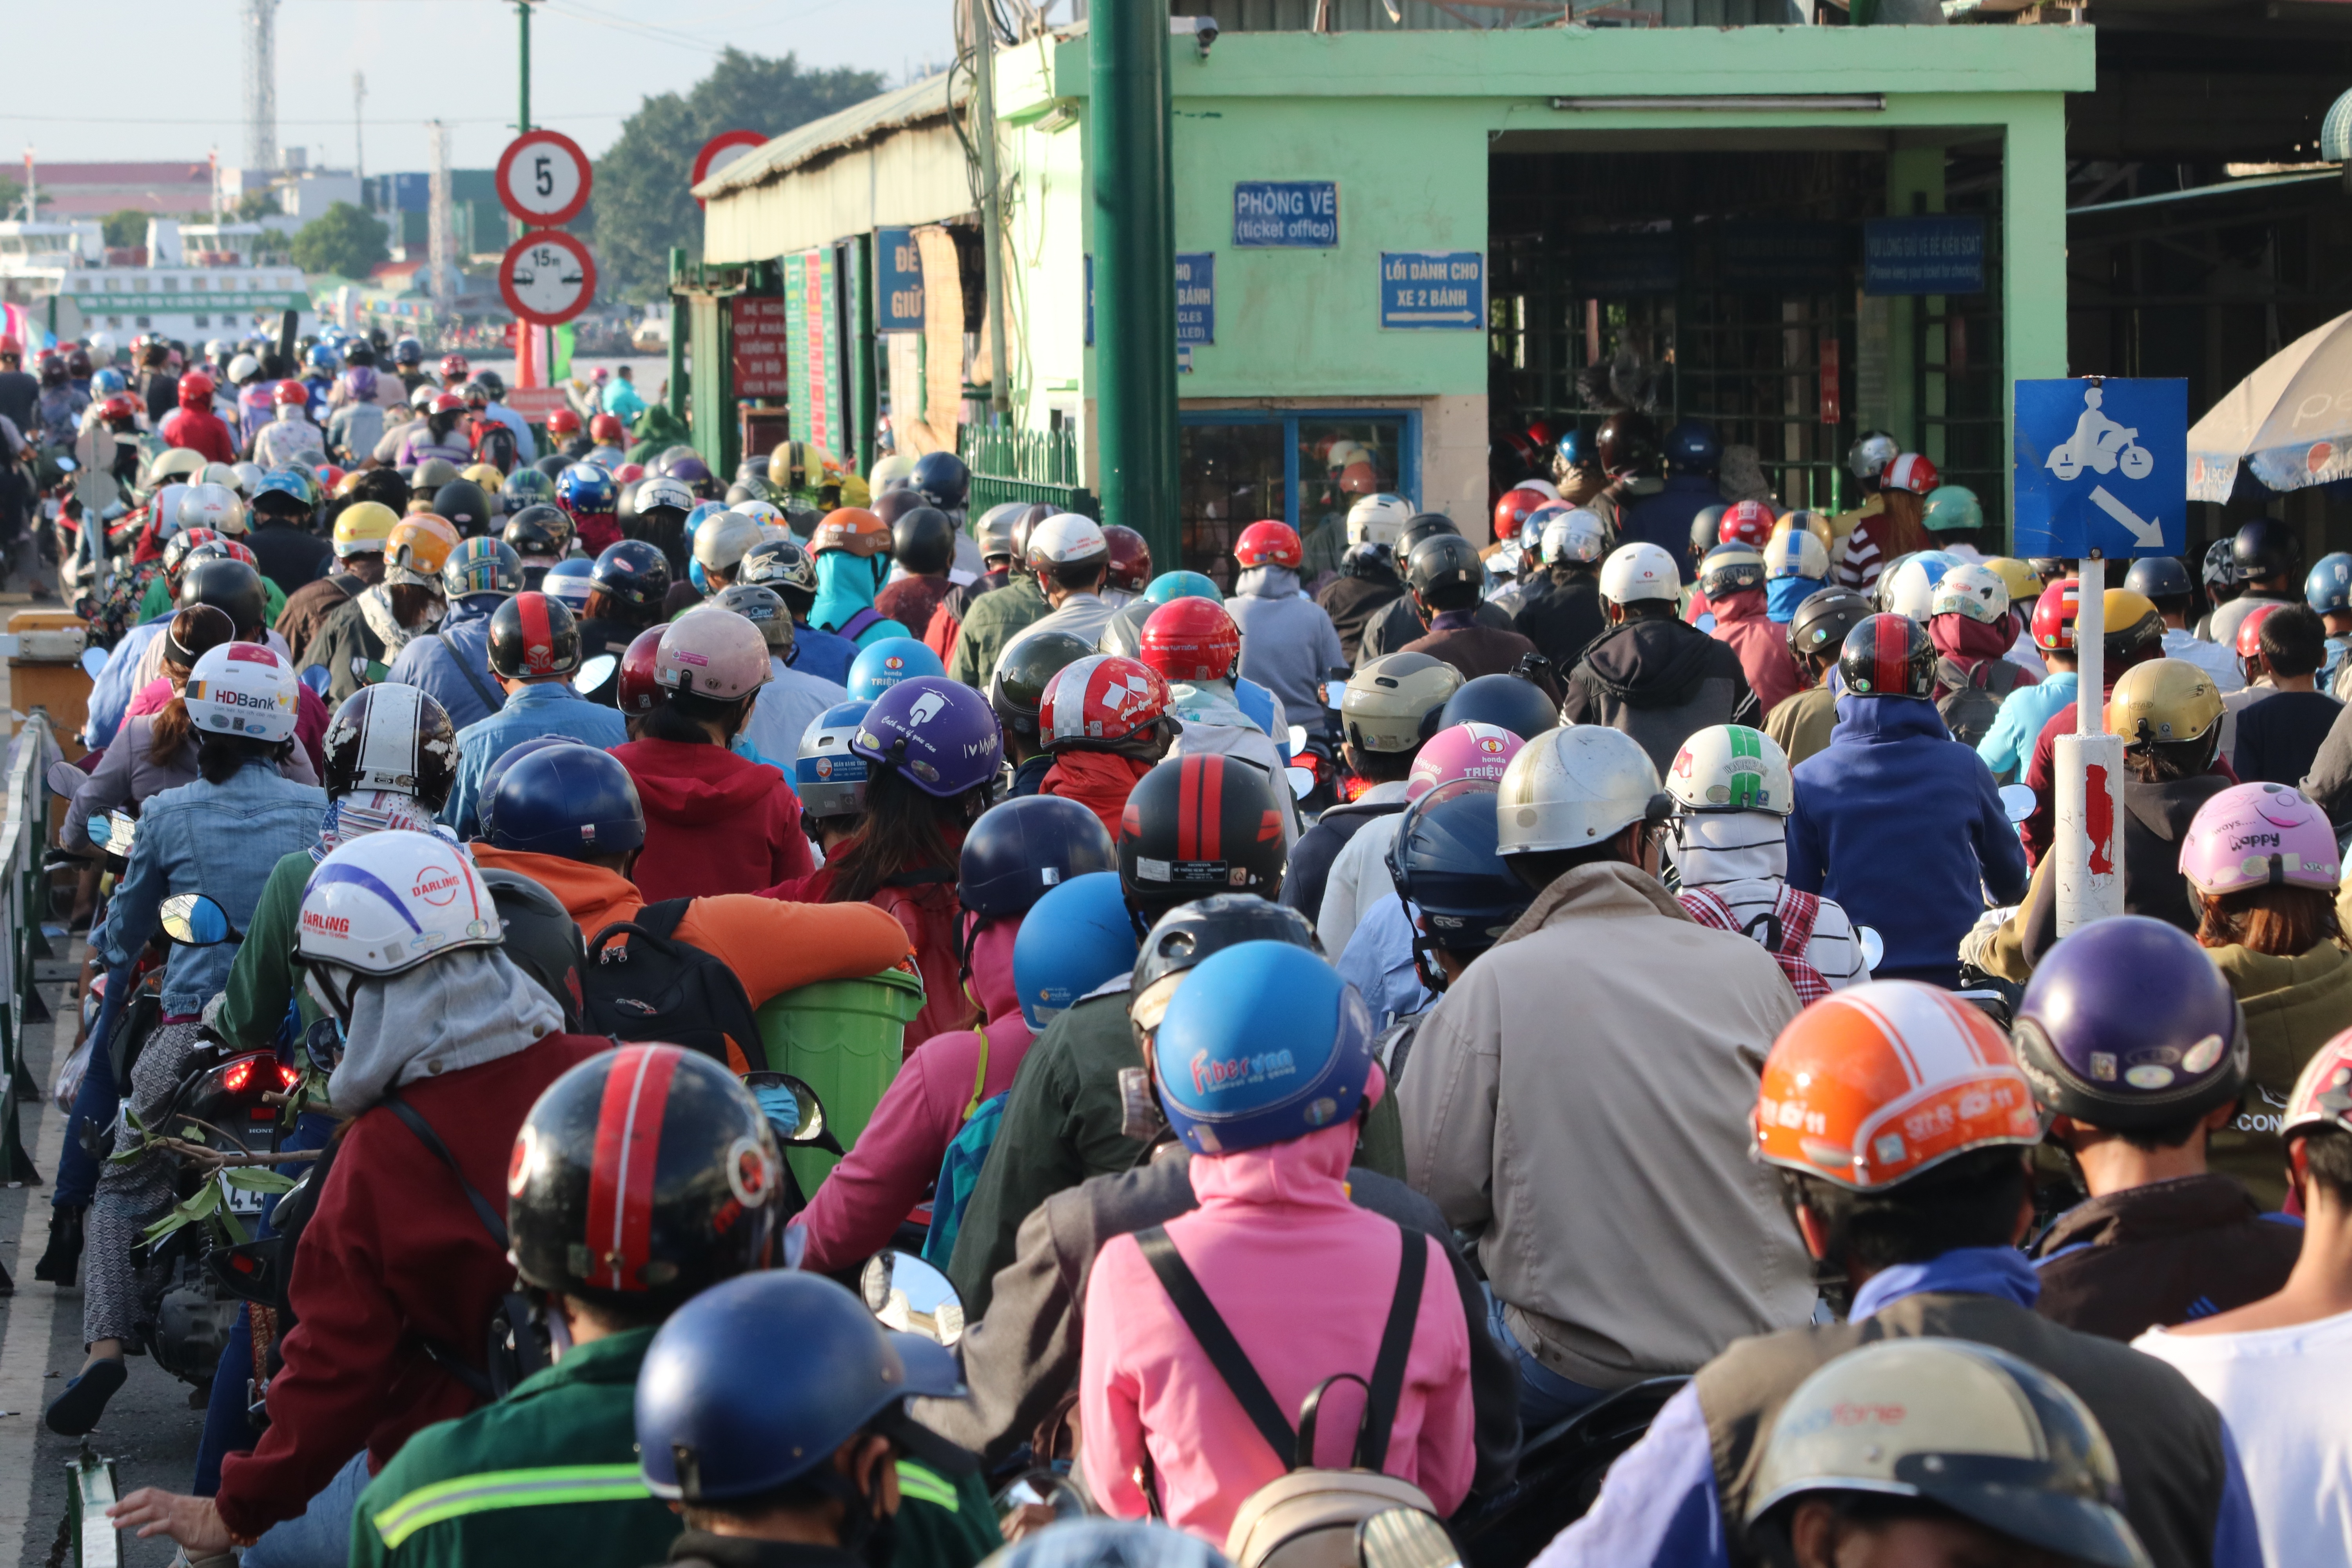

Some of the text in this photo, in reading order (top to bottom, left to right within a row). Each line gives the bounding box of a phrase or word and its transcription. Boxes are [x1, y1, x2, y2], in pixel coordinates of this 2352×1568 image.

[535, 158, 554, 196] 5
[1238, 185, 1304, 215] PHÒNG
[1238, 218, 1335, 242] (ticket office)
[1176, 263, 1191, 281] HO
[1386, 258, 1479, 281] LỐI DÀNH CHO
[1178, 285, 1211, 306] BÁNH
[1397, 286, 1467, 307] XE 2 BÁNH
[1178, 311, 1203, 323] CLES
[1177, 327, 1205, 339] LLED)
[216, 689, 275, 710] HDBank
[979, 738, 990, 756] My
[1463, 764, 1504, 779] TRIỆU
[2228, 832, 2280, 852] happy
[412, 876, 460, 897] DARLING
[303, 910, 350, 933] DARLING
